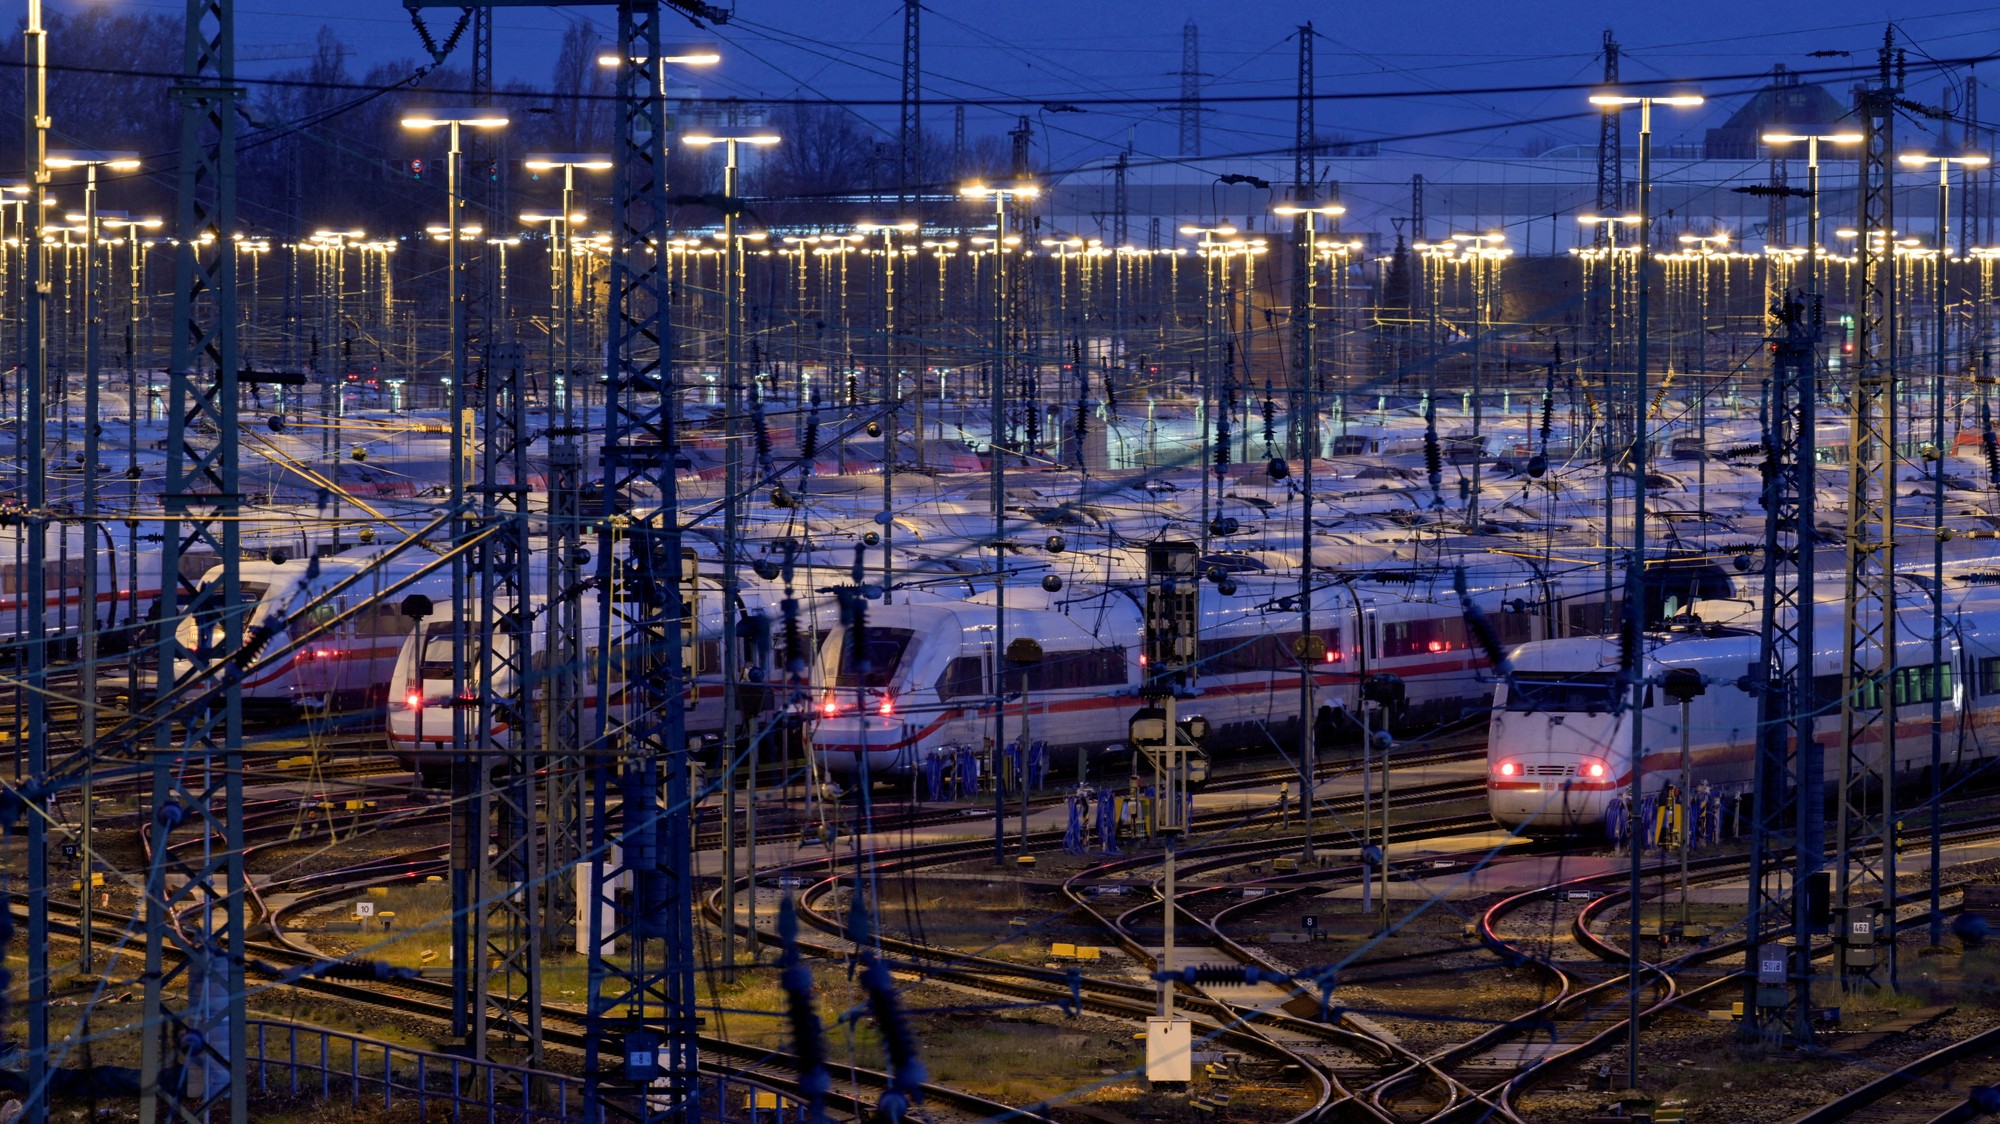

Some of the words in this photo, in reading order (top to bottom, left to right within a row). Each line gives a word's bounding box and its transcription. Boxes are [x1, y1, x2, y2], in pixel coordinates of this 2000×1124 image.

[361, 906, 369, 914] 10
[1307, 918, 1312, 926] 8
[1855, 924, 1868, 932] 462
